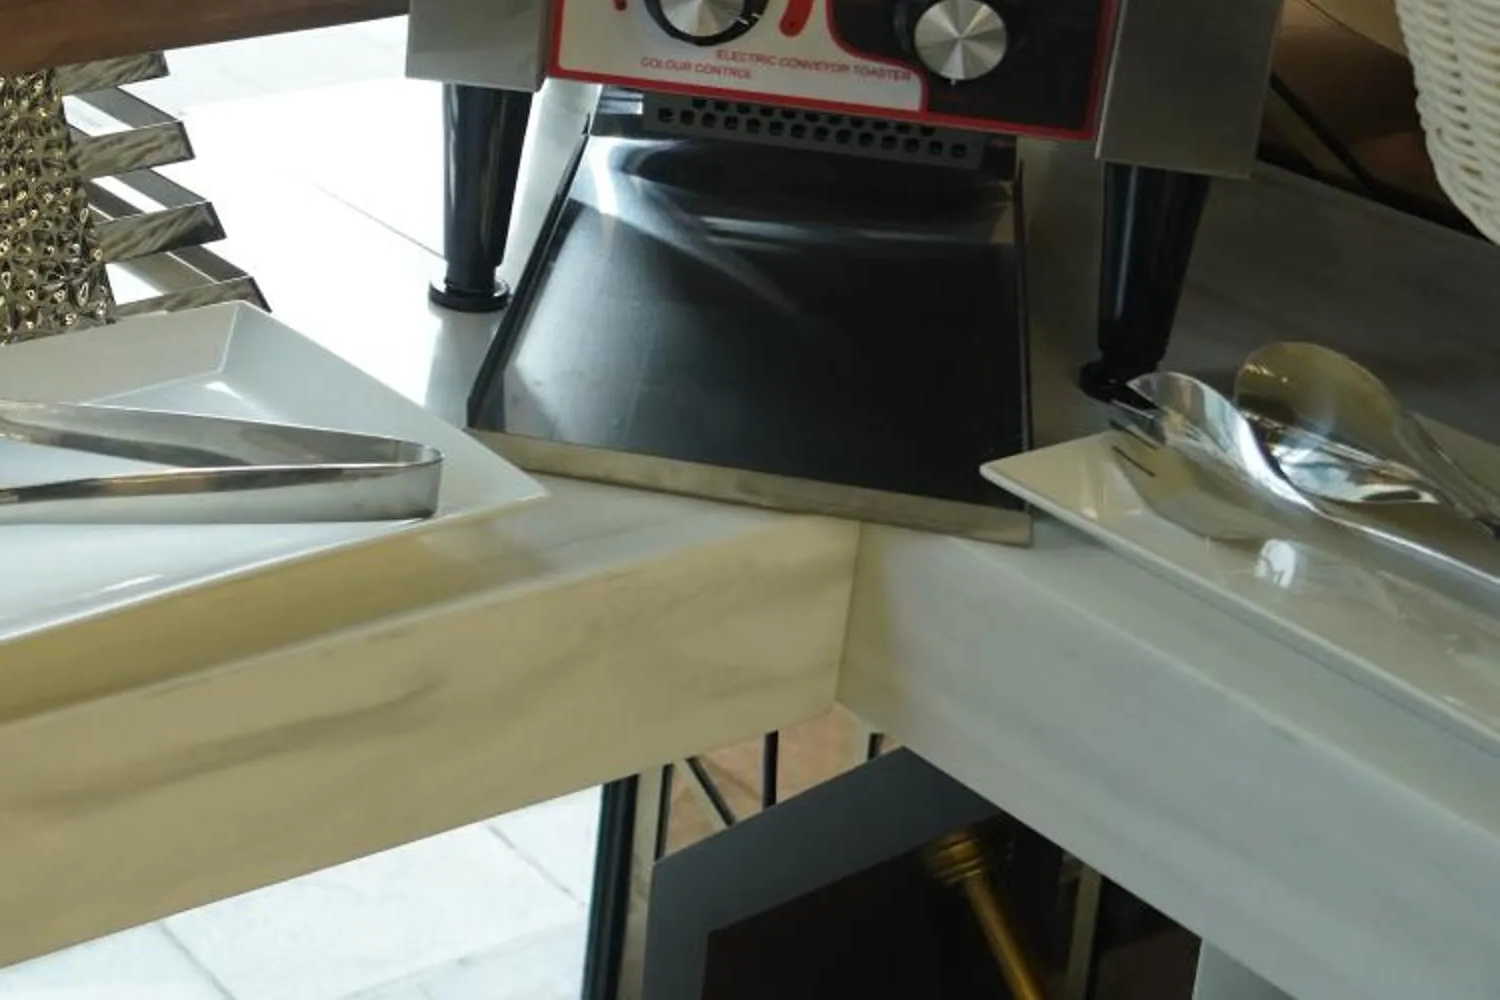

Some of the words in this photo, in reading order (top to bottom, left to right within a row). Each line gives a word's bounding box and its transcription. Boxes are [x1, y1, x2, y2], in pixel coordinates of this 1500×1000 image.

[640, 56, 692, 73] COLOUR
[695, 60, 752, 80] CONTROL
[716, 49, 776, 67] ELECTRIC
[779, 56, 850, 74] CONVEYOR
[853, 64, 912, 82] TOASTER
